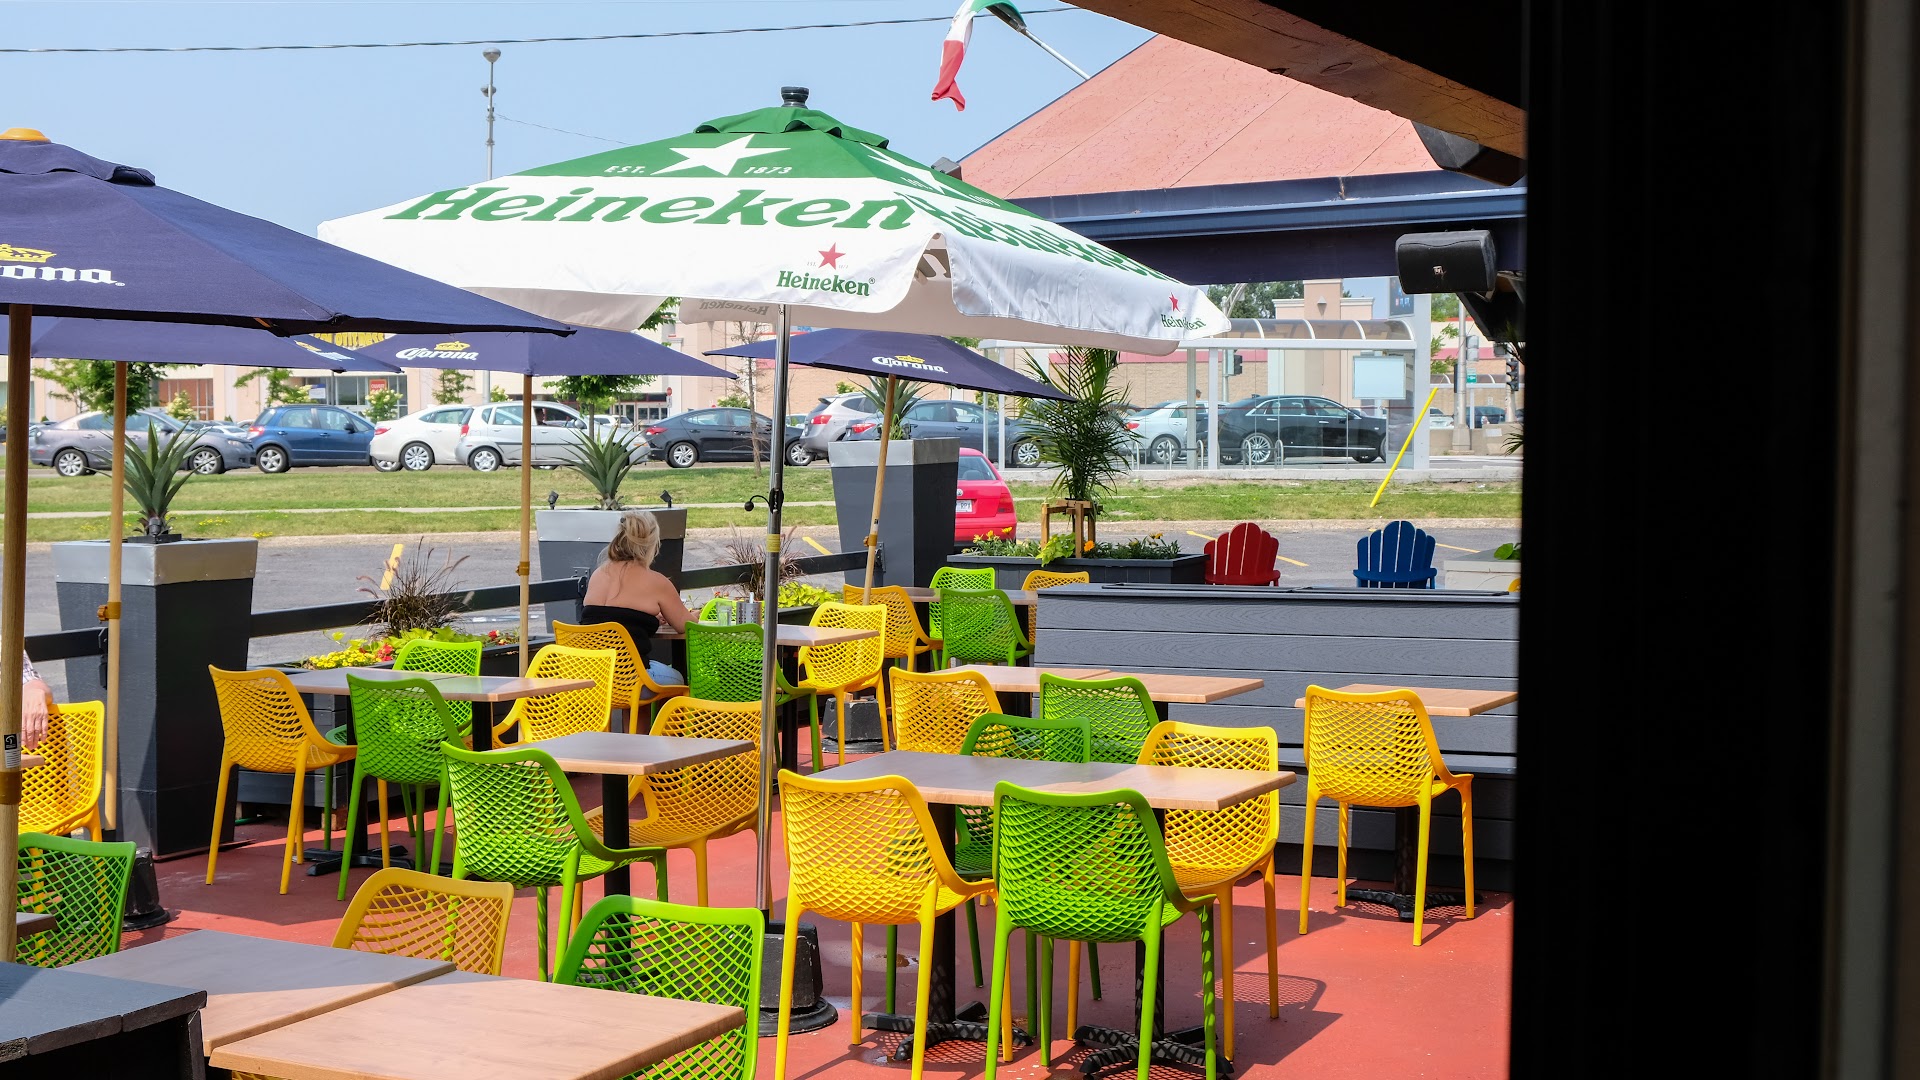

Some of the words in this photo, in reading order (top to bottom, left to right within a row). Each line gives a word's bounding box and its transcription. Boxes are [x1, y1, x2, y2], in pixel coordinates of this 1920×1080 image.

[603, 165, 647, 174] EST.
[743, 166, 793, 175] 1873
[382, 186, 916, 230] Heineken
[776, 270, 870, 297] Heineken
[1160, 313, 1207, 331] Heinken
[395, 348, 479, 361] Corona
[871, 355, 949, 374] Corona
